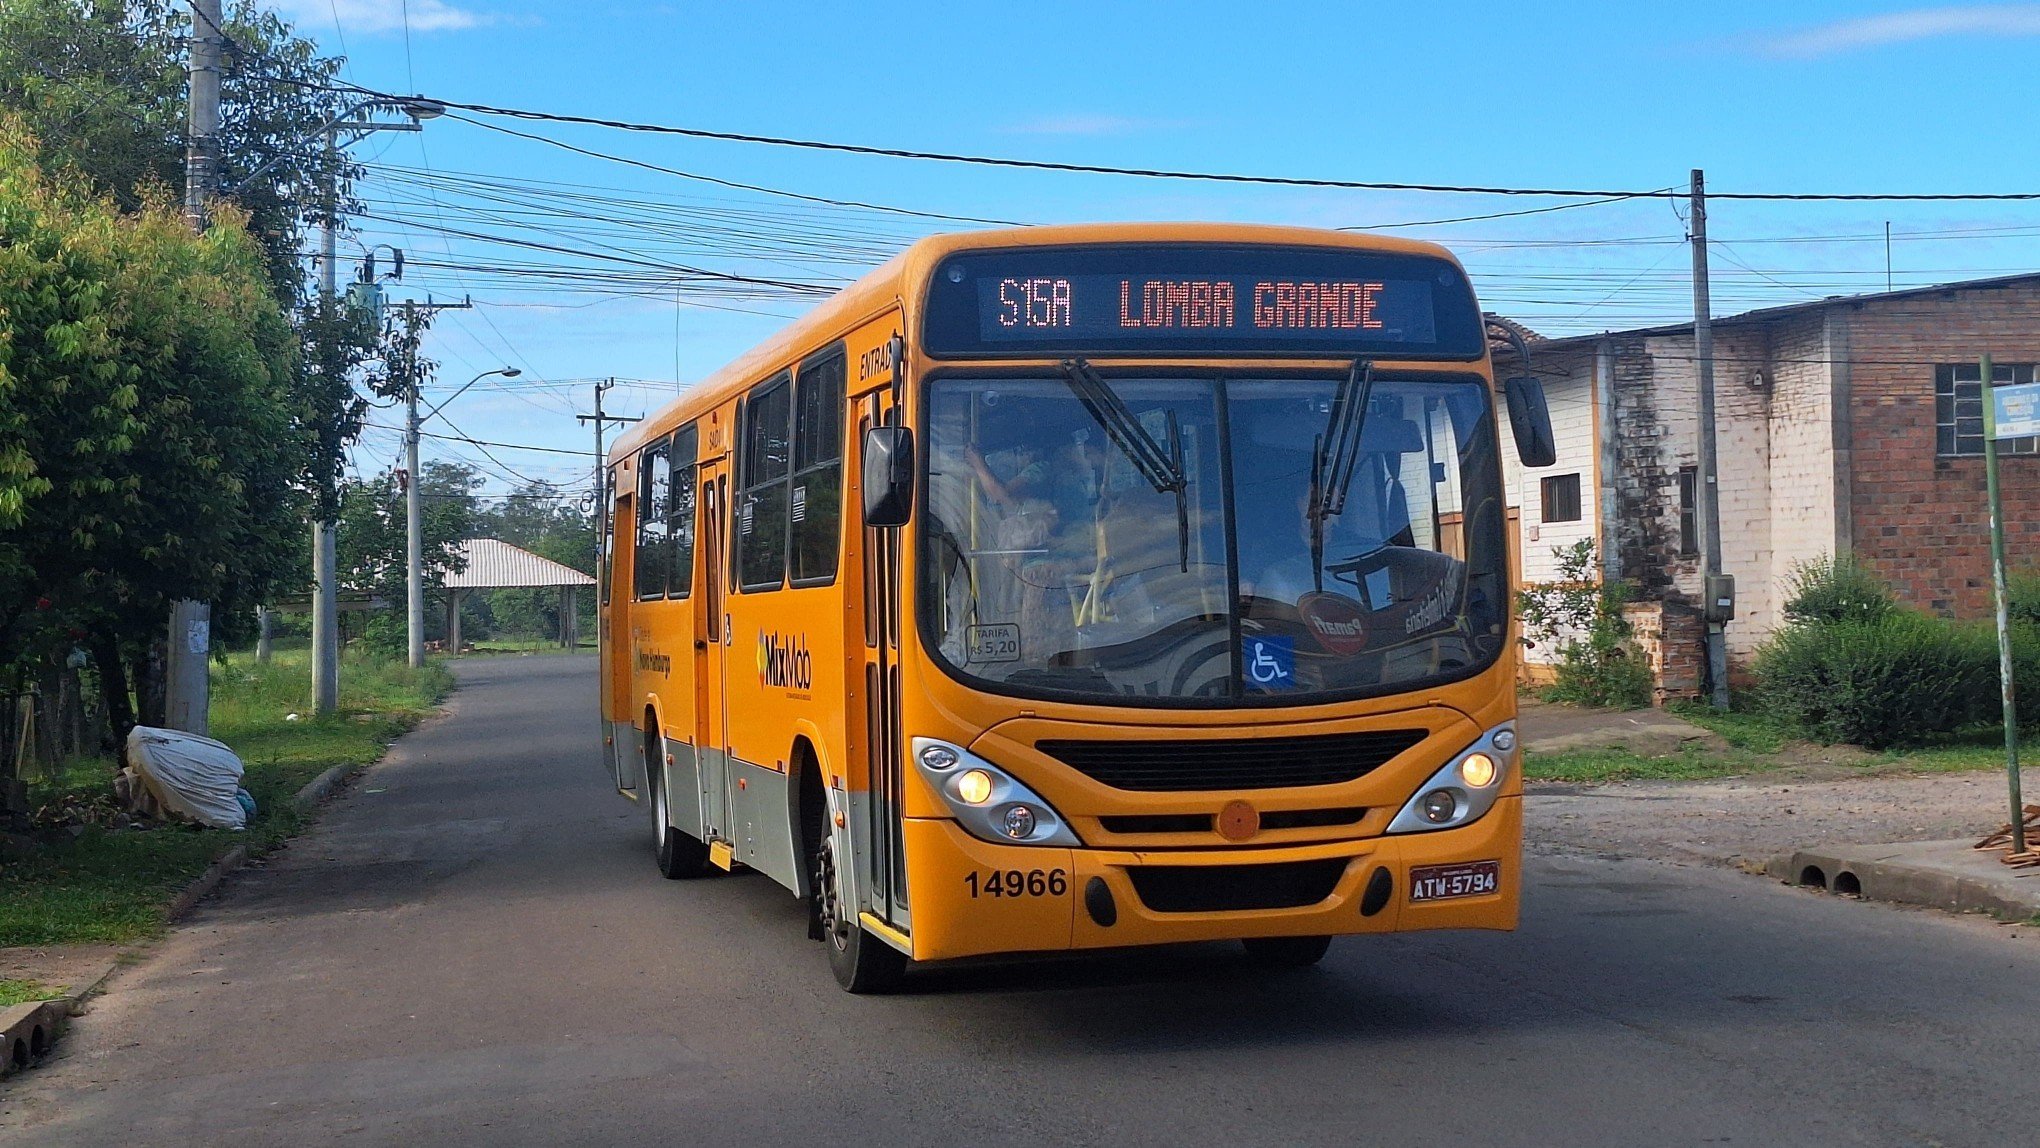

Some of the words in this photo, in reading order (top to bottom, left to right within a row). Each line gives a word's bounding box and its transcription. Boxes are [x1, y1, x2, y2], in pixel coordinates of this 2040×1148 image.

[1000, 279, 1070, 326] S15A
[1120, 280, 1234, 328] LOMBA
[1254, 281, 1384, 329] GRANDE
[860, 340, 893, 382] ENTRAD
[971, 645, 982, 655] R$
[985, 641, 1016, 656] 5,20
[975, 629, 1009, 639] TARIFA
[765, 630, 812, 690] MixMob
[964, 868, 1067, 899] 14966
